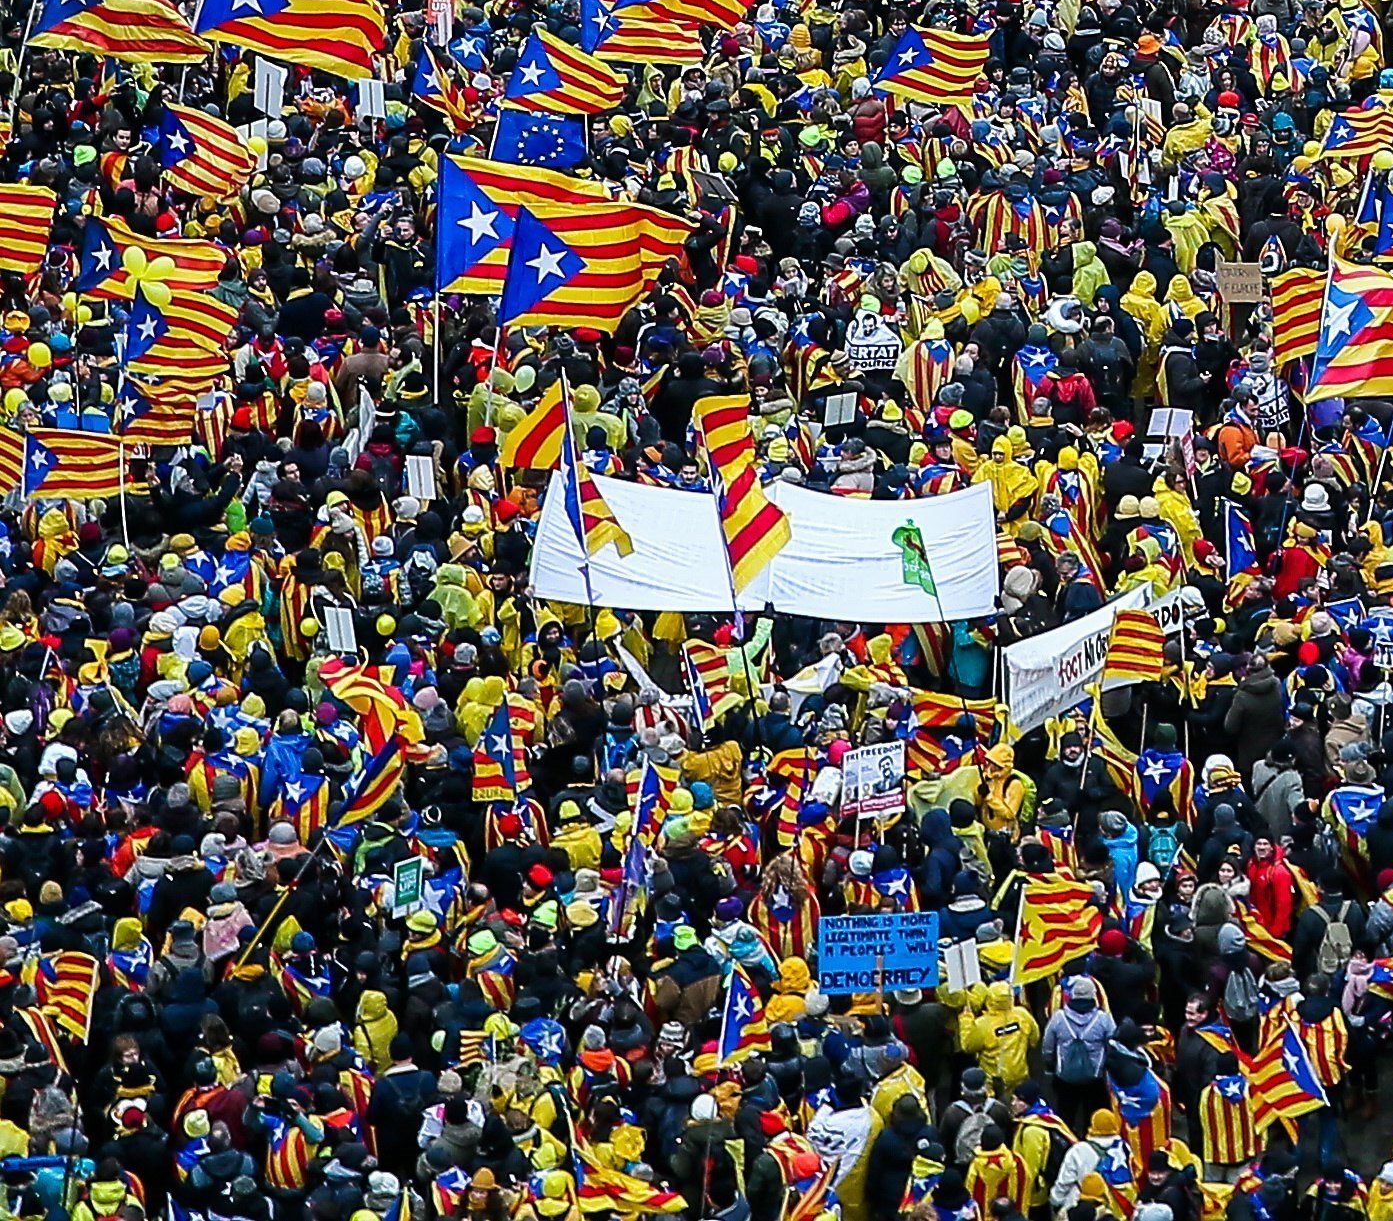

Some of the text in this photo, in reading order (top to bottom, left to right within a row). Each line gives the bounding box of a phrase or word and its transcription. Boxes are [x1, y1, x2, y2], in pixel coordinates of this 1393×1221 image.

[850, 345, 898, 359] ERTAT
[859, 743, 903, 759] FREEDOM
[824, 915, 932, 929] NOTHING IS MORE
[825, 928, 927, 943] LEGITIMATE THAN
[825, 943, 835, 955] A
[905, 941, 935, 954] WILL
[820, 967, 930, 988] DEMOCRACY
